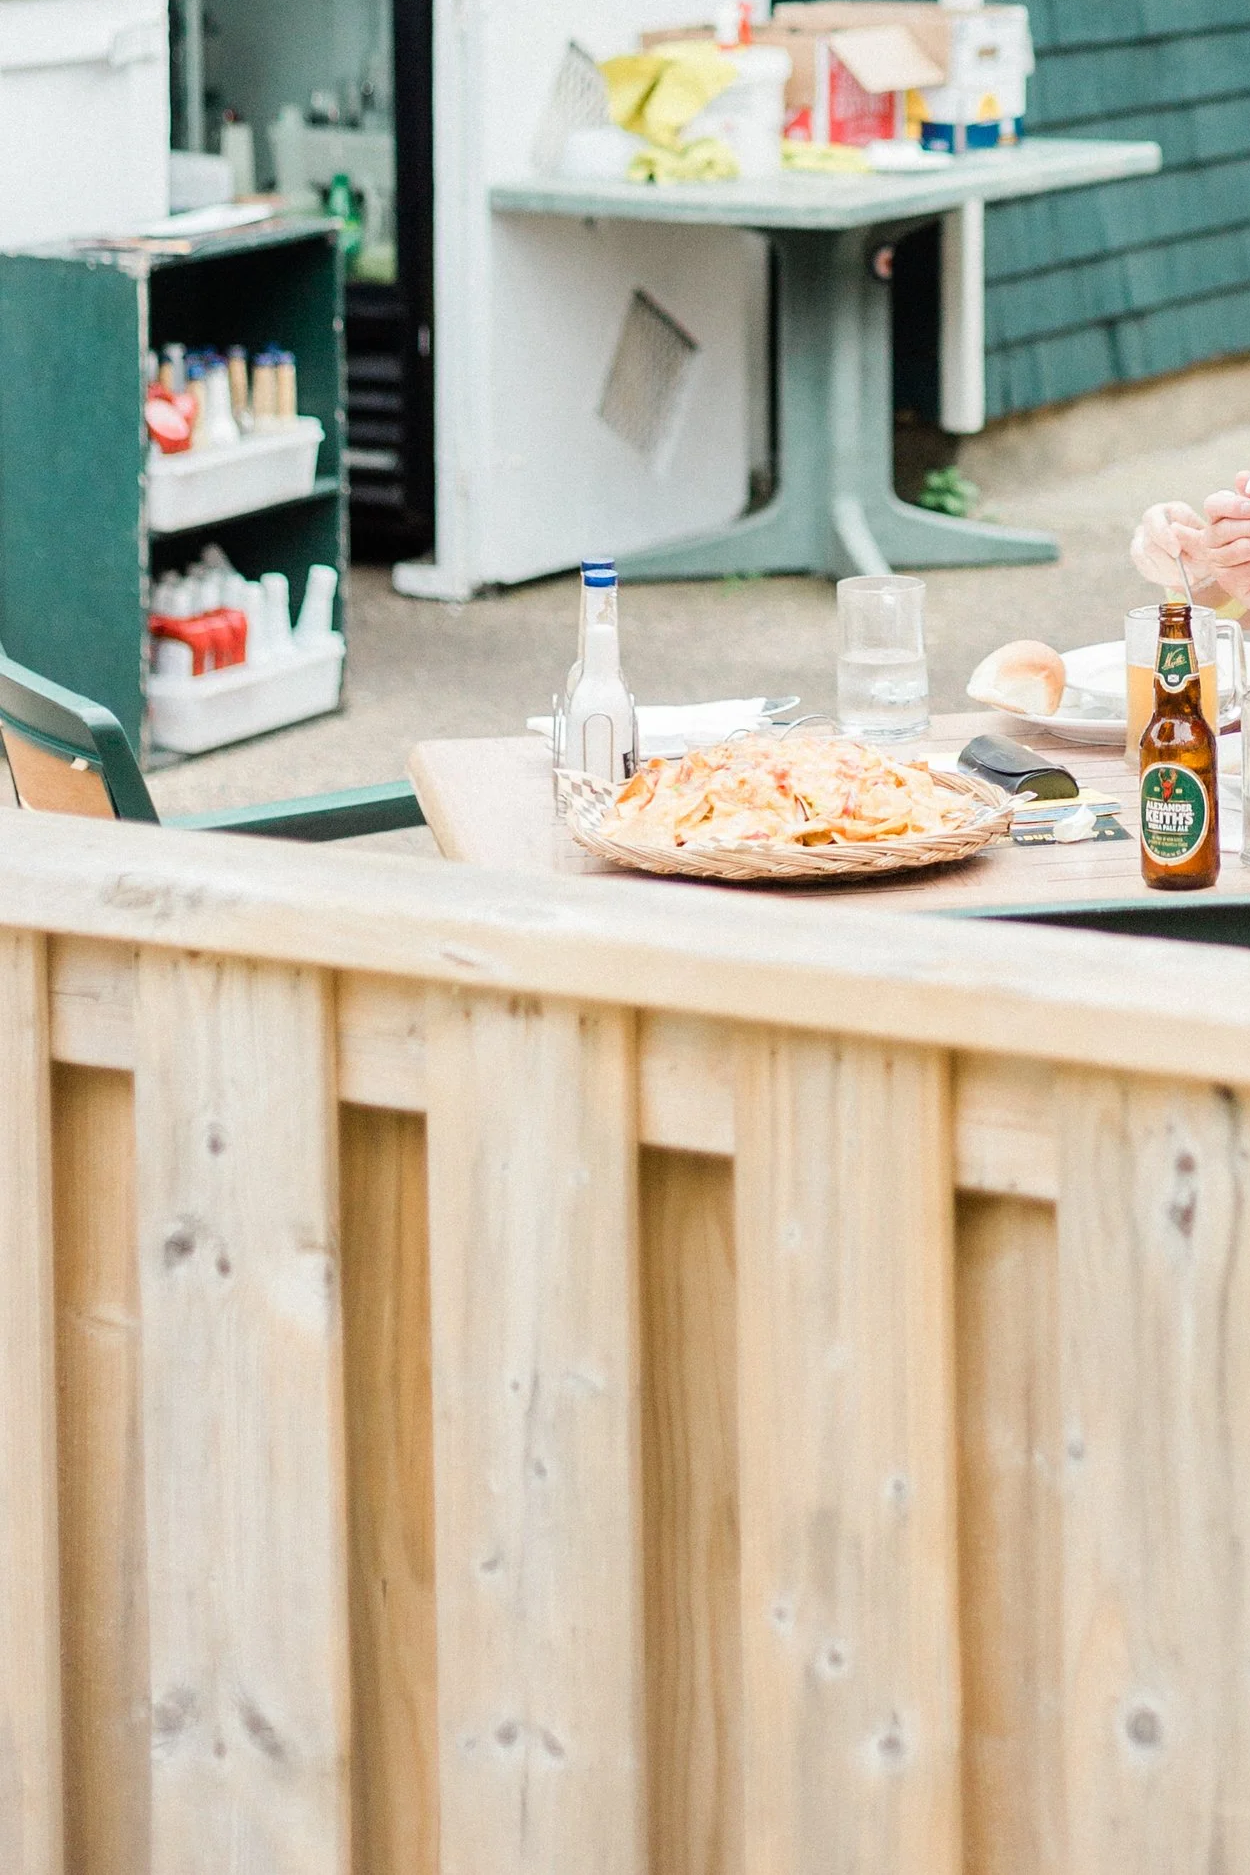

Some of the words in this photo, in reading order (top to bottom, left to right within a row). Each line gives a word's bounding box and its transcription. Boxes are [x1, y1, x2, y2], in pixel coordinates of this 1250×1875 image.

[1146, 800, 1193, 813] ALEXANDER
[1145, 808, 1194, 827] KEITH'S
[1163, 824, 1176, 832] PALE
[1177, 825, 1189, 833] ALE
